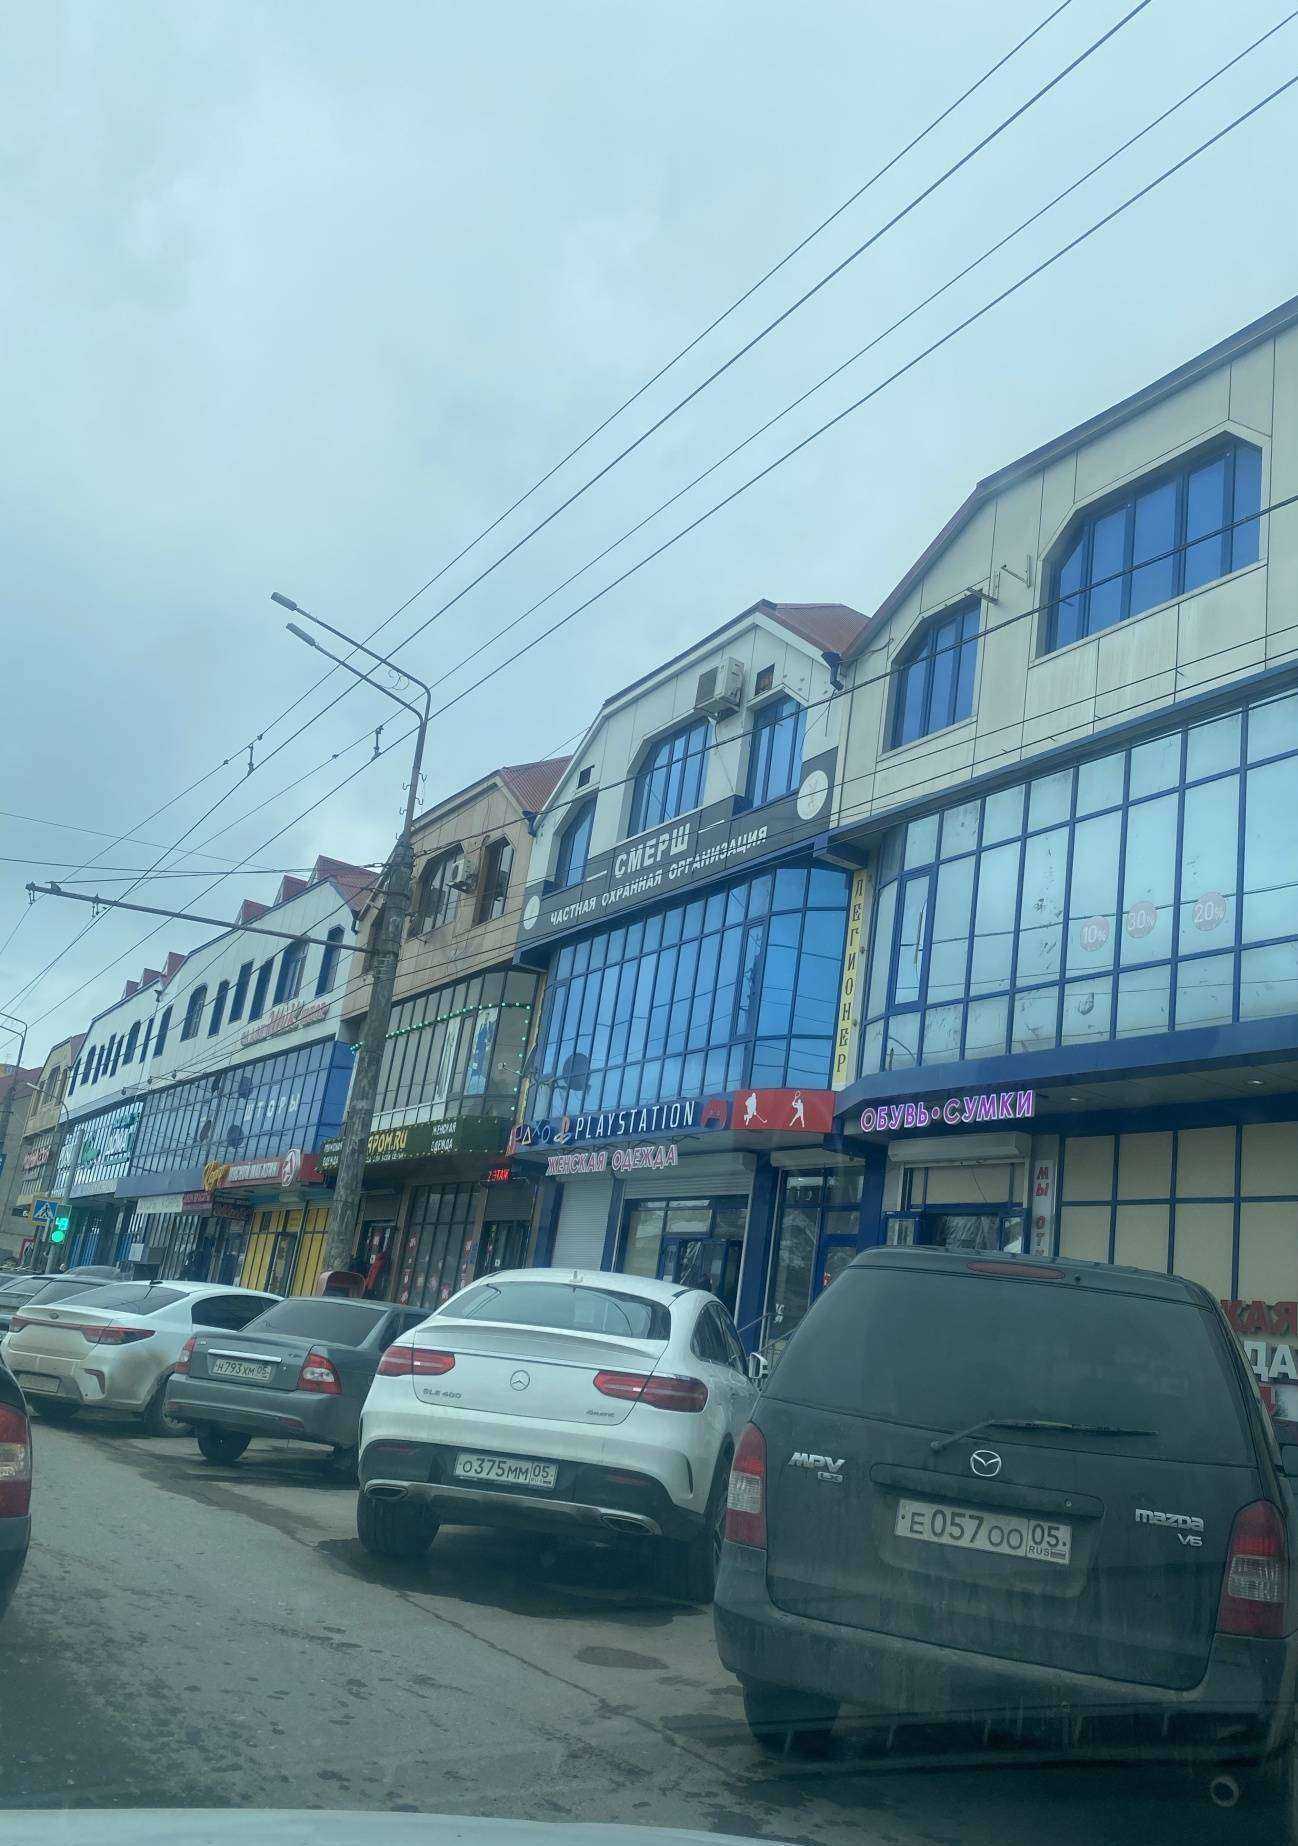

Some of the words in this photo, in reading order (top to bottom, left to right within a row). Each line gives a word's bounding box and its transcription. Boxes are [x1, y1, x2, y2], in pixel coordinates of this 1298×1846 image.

[614, 823, 690, 878] СМЕРШ
[550, 897, 597, 925] ЧАСТНАЯ
[601, 869, 663, 907] ОХРАННАЯ
[668, 825, 768, 880] ОРГАНИЗАЦИЯ
[1128, 911, 1155, 931] 30%
[1194, 901, 1225, 923] 20%
[1082, 924, 1107, 945] 10%
[836, 879, 865, 1073] ЛЕГИОНЕР
[244, 1093, 300, 1121] ШТОРЫ
[575, 1101, 697, 1140] PLAYSTATION
[545, 1150, 607, 1176] ЖЕНСКАЯ
[611, 1144, 679, 1172] ОДЕЖДА
[217, 1361, 256, 1376] Н793ХМ
[462, 1457, 530, 1481] О375ММ
[533, 1464, 549, 1479] 05
[787, 1452, 846, 1473] MPV
[909, 1508, 1023, 1550] Е057ОО
[1031, 1523, 1060, 1548] 05
[1177, 1532, 1203, 1547] V6
[1028, 1545, 1050, 1557] RUS
